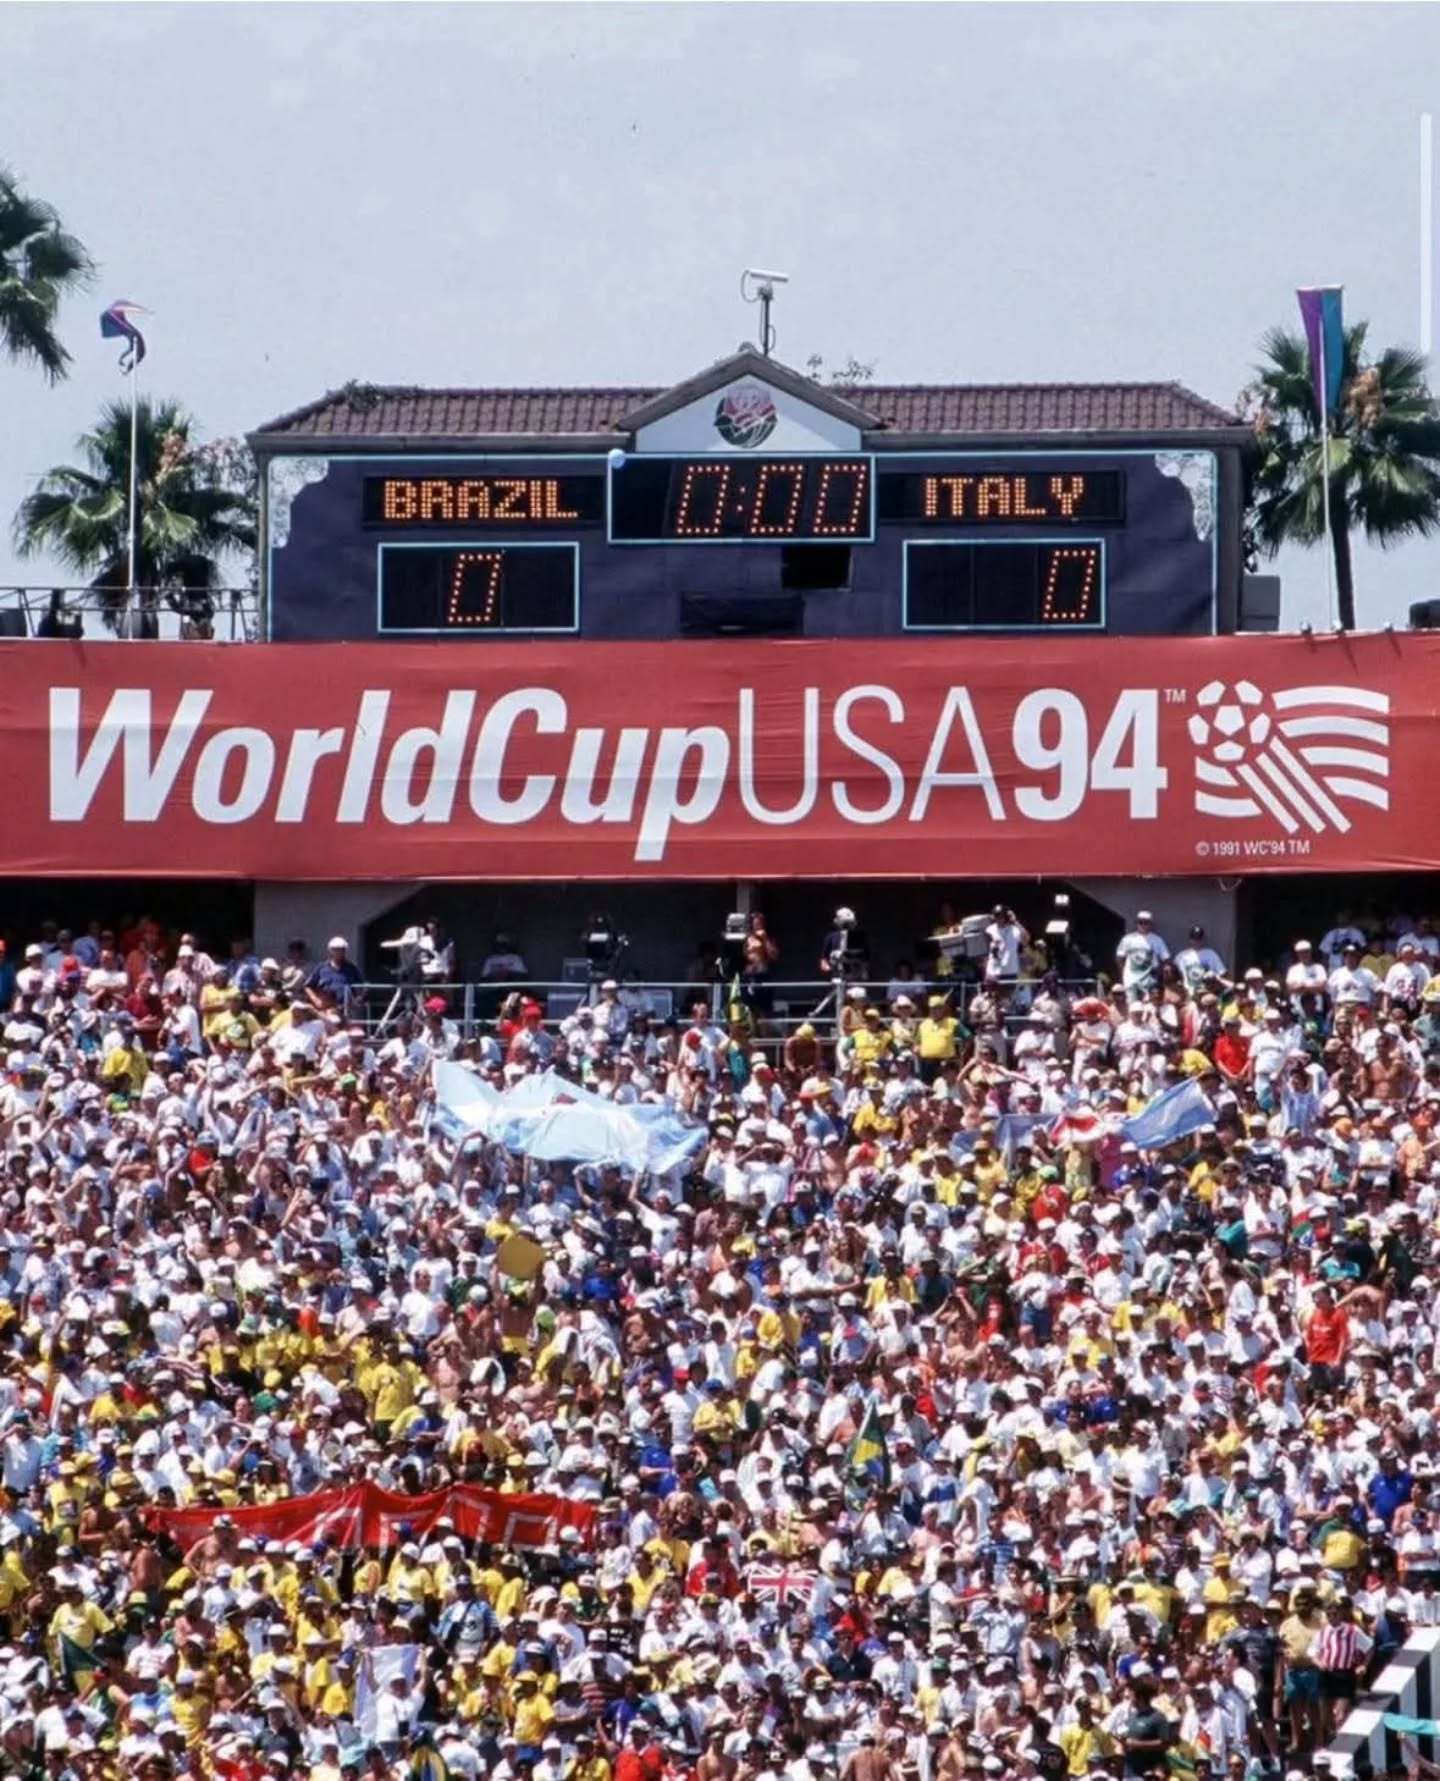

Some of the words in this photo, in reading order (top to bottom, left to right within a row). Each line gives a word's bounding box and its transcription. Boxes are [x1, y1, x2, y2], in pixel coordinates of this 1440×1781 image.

[383, 480, 578, 519] BRAZIL
[676, 464, 867, 534] 0:00
[925, 476, 1085, 517] ITALY
[445, 553, 501, 624] 0
[1043, 549, 1096, 620] 0
[1213, 841, 1240, 856] 1991
